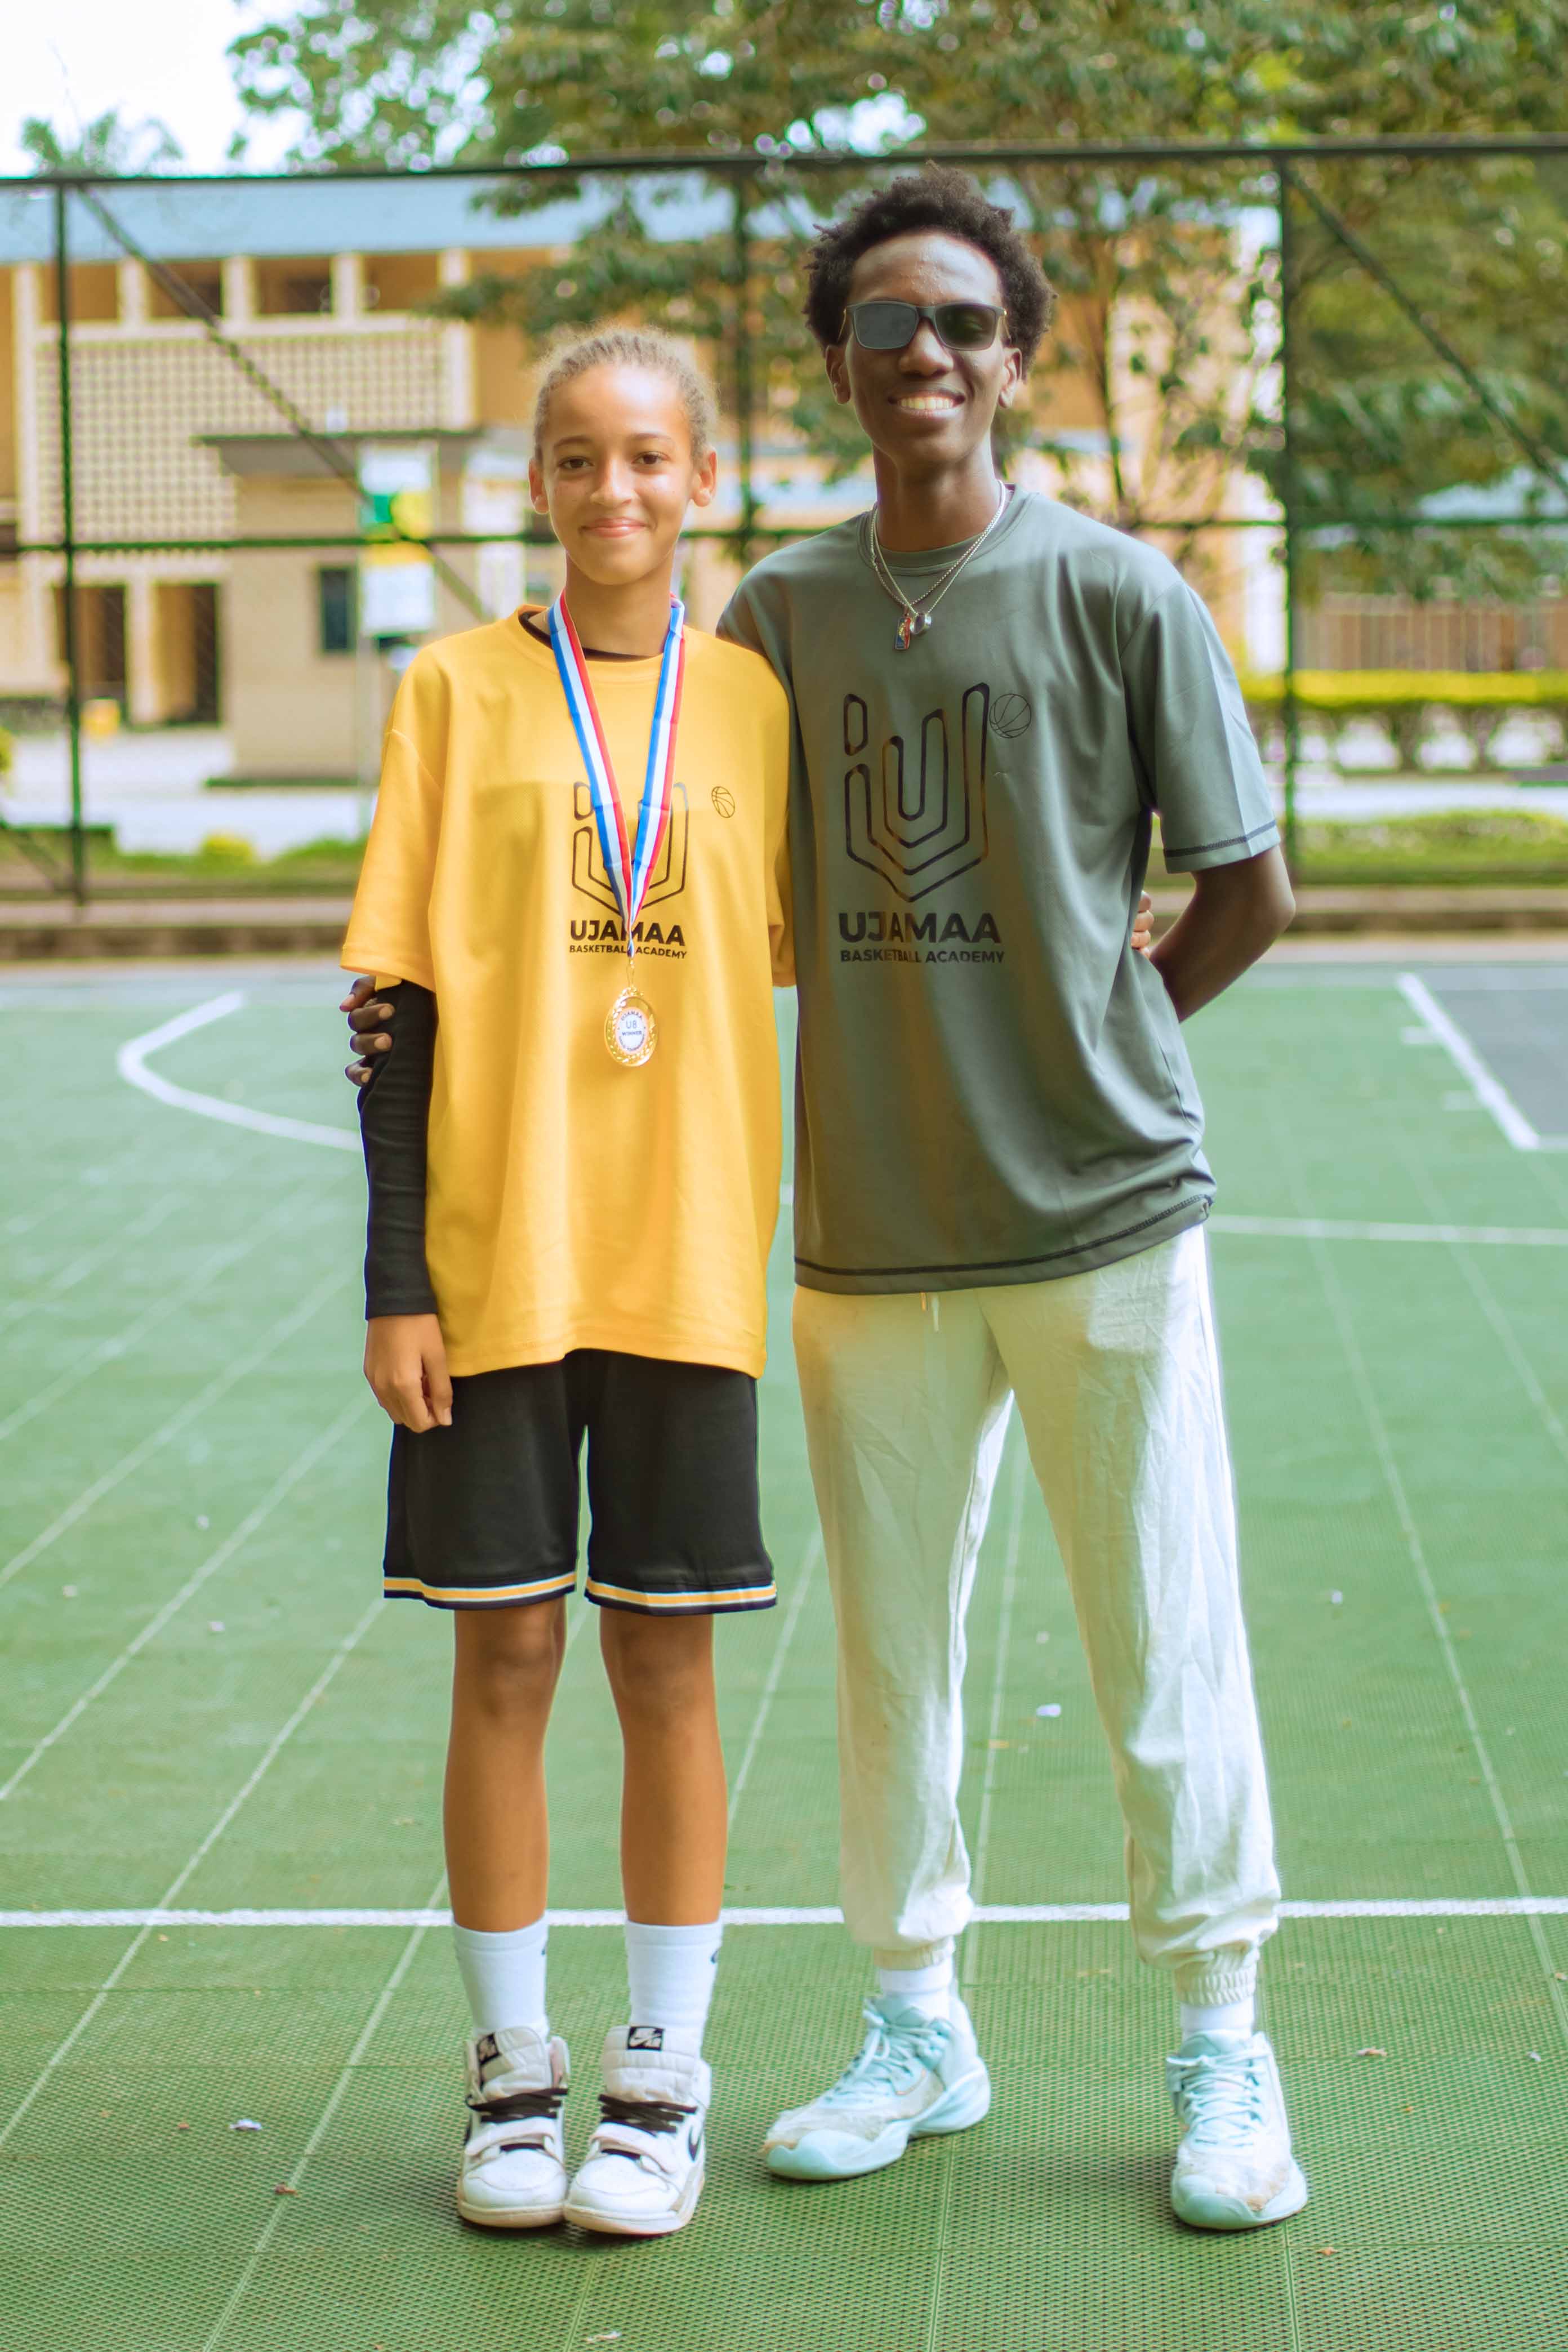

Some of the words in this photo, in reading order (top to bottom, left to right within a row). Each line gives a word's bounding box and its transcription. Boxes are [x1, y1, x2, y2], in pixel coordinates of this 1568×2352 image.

[571, 920, 685, 947] UJAMAA
[839, 911, 1002, 943] UJAMAA
[569, 945, 628, 954] BASKETBAL
[635, 946, 687, 959] ACADEMY
[840, 948, 921, 963] BASKETBALL
[925, 950, 1005, 964] ACADEMY
